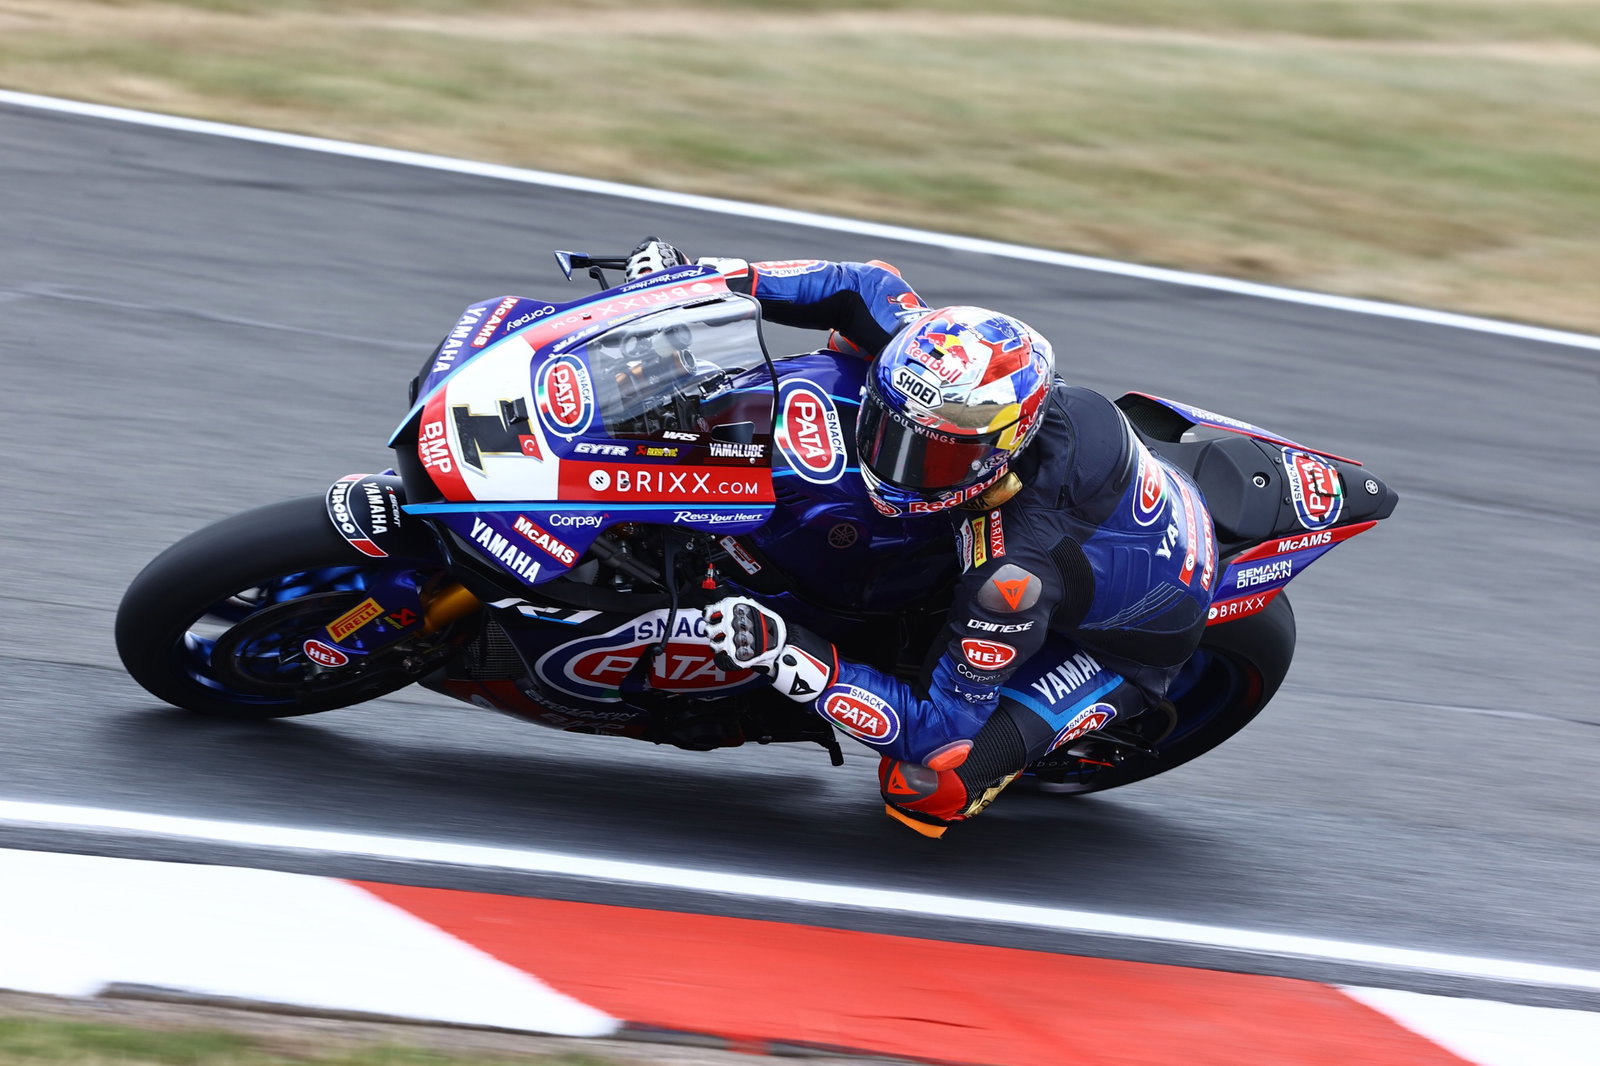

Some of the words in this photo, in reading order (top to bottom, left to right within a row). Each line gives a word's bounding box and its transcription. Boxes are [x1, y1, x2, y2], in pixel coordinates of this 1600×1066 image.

[474, 297, 519, 346] McAMS
[506, 305, 556, 332] Corpay
[433, 306, 487, 373] YAMAHA
[905, 340, 931, 366] Red
[929, 356, 963, 384] Bull
[552, 368, 577, 419] PATA
[577, 370, 591, 402] SNACK
[895, 371, 937, 406] SHOEI
[450, 399, 534, 475] 1
[663, 431, 700, 441] WRS
[795, 400, 826, 460] PATA
[826, 409, 844, 455] SNACK
[888, 408, 909, 427] YOU
[914, 425, 956, 445] WINGS
[419, 436, 433, 468] TAPPI
[425, 421, 452, 473] BMP
[574, 443, 630, 456] GYTR
[709, 443, 765, 458] YAMALUBE
[909, 491, 964, 513] Red
[965, 463, 1008, 502] Bull
[1289, 464, 1302, 500] SNACK
[1303, 461, 1327, 511] PATA
[362, 482, 388, 535] YAMAHA
[549, 513, 603, 528] Corpay
[673, 511, 708, 522] Revs
[708, 513, 735, 524] Your
[733, 513, 763, 523] Heart
[470, 517, 541, 583] YAMAHA
[514, 517, 576, 564] McAMS
[992, 520, 1004, 556] BRIXX
[1277, 532, 1332, 553] McAMS
[1237, 559, 1292, 580] SEMAKIN
[1250, 569, 1292, 587] DEPAN
[330, 602, 379, 639] PIRELLI
[1220, 596, 1266, 617] BRIXX
[638, 617, 706, 641] SNAC
[967, 619, 1035, 633] DAINESE
[310, 648, 340, 665] HEL
[968, 648, 1005, 662] HEL
[1031, 650, 1102, 705] YAMA
[832, 699, 878, 734] PATA
[851, 689, 885, 711] SNACK
[1069, 706, 1097, 730] SNACK
